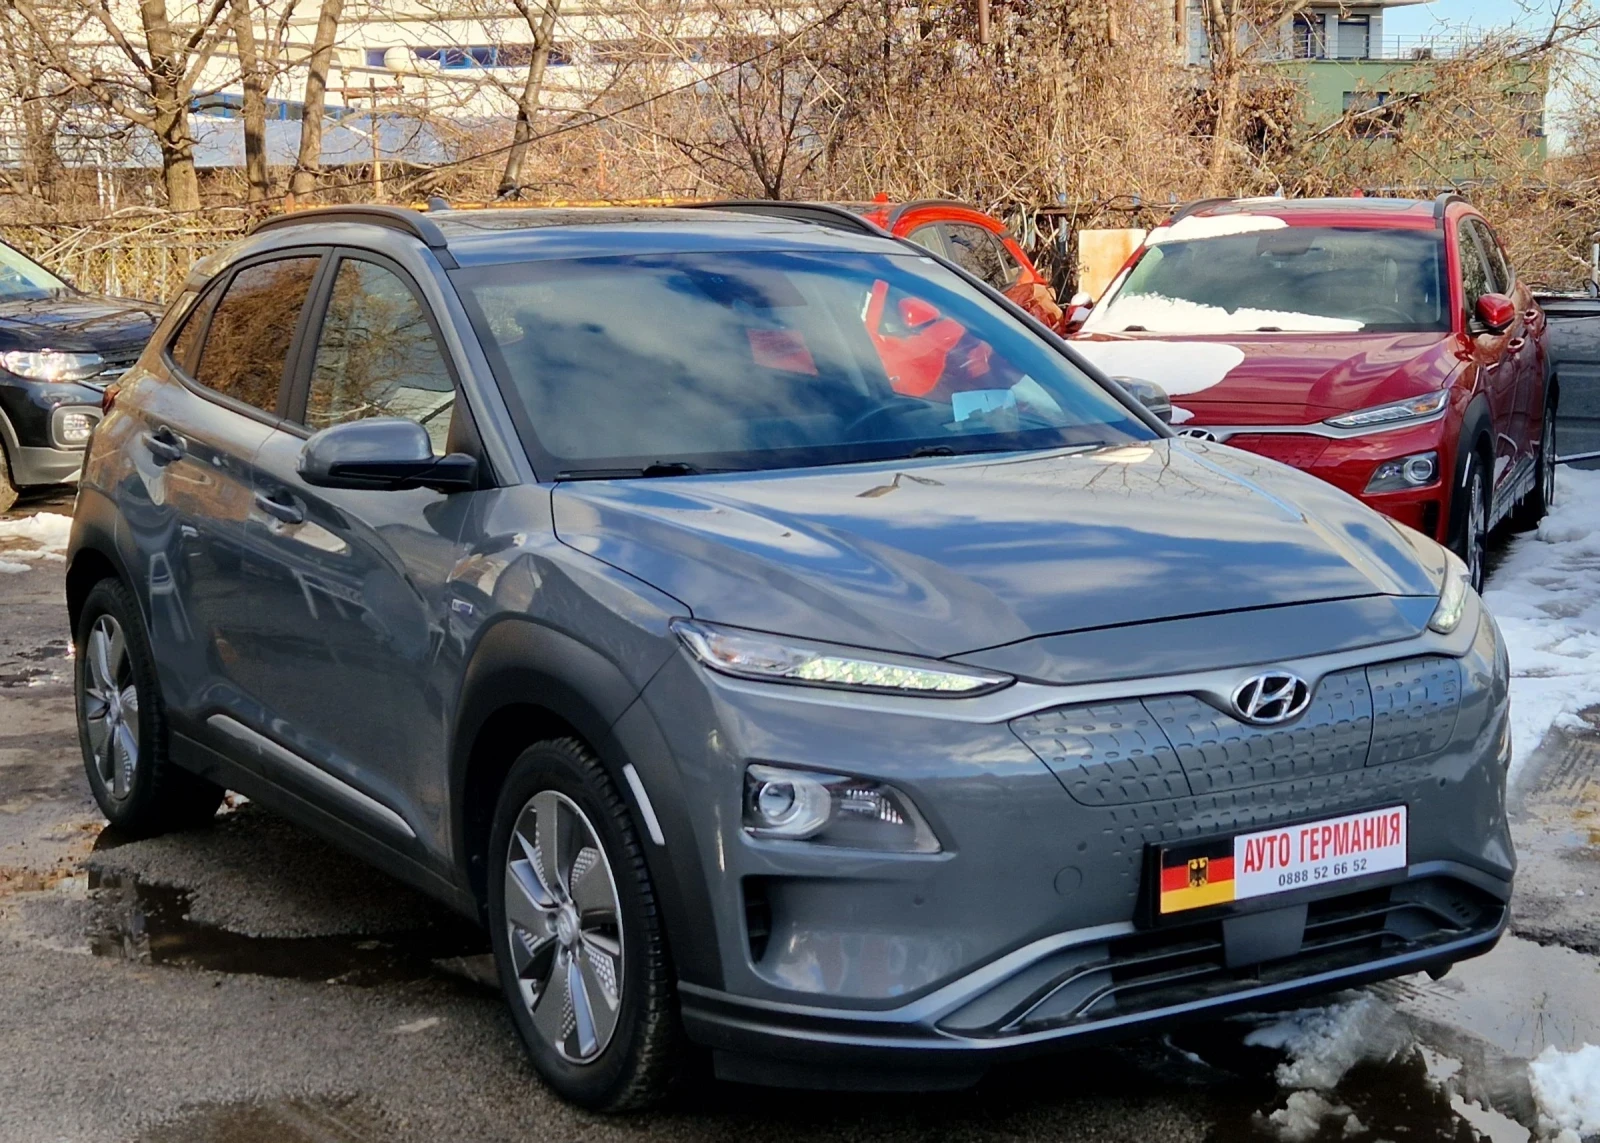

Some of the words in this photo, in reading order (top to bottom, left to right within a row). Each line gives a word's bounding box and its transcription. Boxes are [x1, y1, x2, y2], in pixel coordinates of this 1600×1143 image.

[1244, 833, 1291, 873] АУТО
[1300, 812, 1400, 863] ГЕРМАНИЯ
[1278, 870, 1308, 886] 0888
[1314, 866, 1328, 879] 52
[1334, 862, 1348, 876] 66
[1353, 858, 1367, 872] 52
